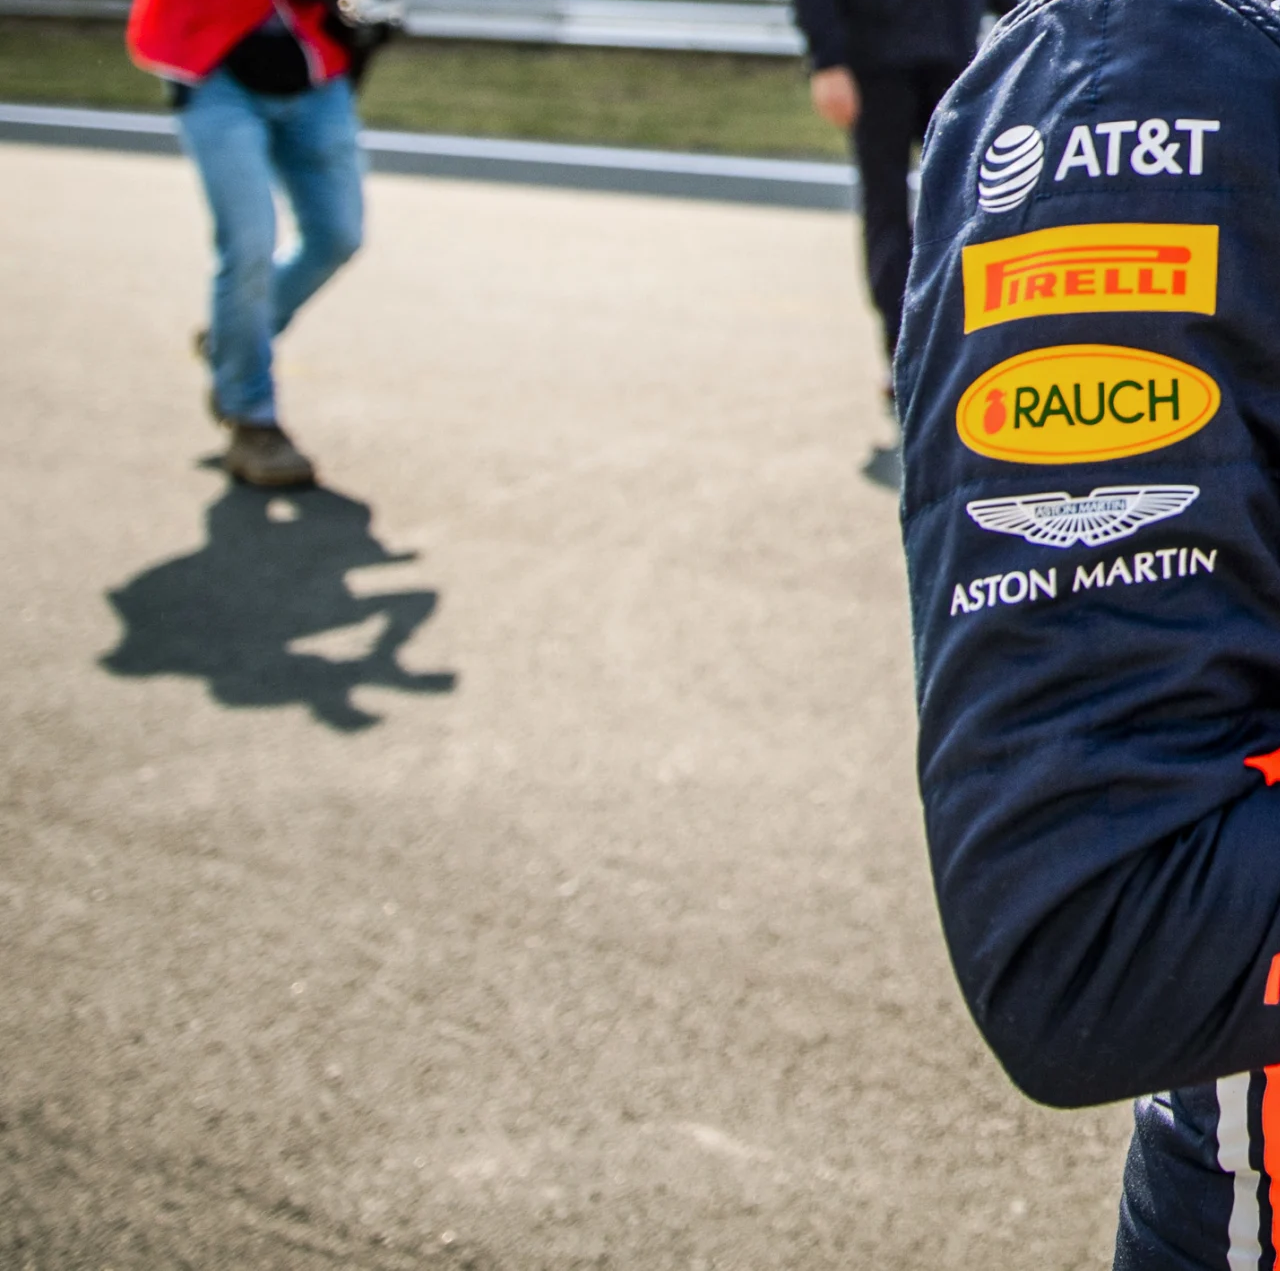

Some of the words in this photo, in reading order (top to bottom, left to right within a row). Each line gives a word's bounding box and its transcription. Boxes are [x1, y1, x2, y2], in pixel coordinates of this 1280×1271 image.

[1054, 118, 1220, 182] AT&T
[983, 244, 1193, 313] PIRELLI
[1013, 378, 1181, 430] RAUCH
[949, 567, 1058, 616] ASTON
[1072, 547, 1218, 593] MARTIN
